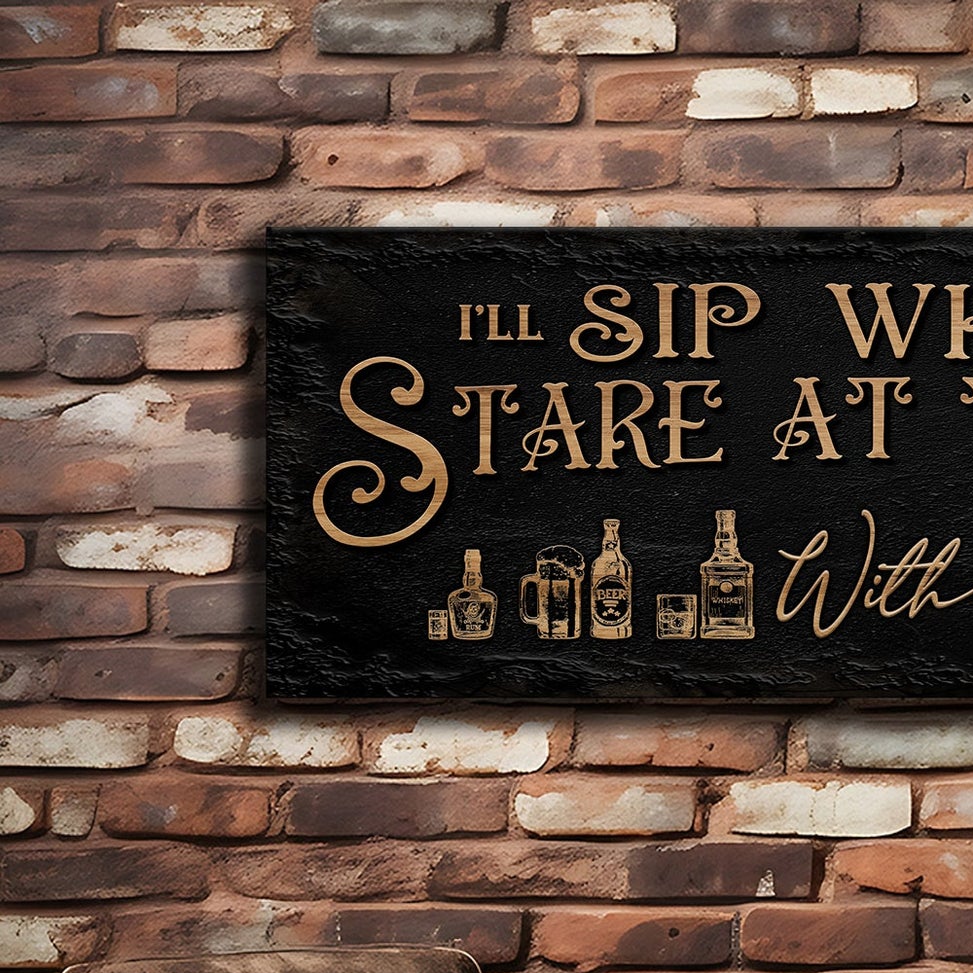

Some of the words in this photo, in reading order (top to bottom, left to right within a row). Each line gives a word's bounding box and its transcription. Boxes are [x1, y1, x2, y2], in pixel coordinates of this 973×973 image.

[458, 304, 544, 341] I'LL
[569, 282, 761, 362] SIP
[312, 355, 724, 547] STARE
[771, 376, 913, 460] AT
[596, 588, 627, 600] BEER
[776, 509, 966, 638] With
